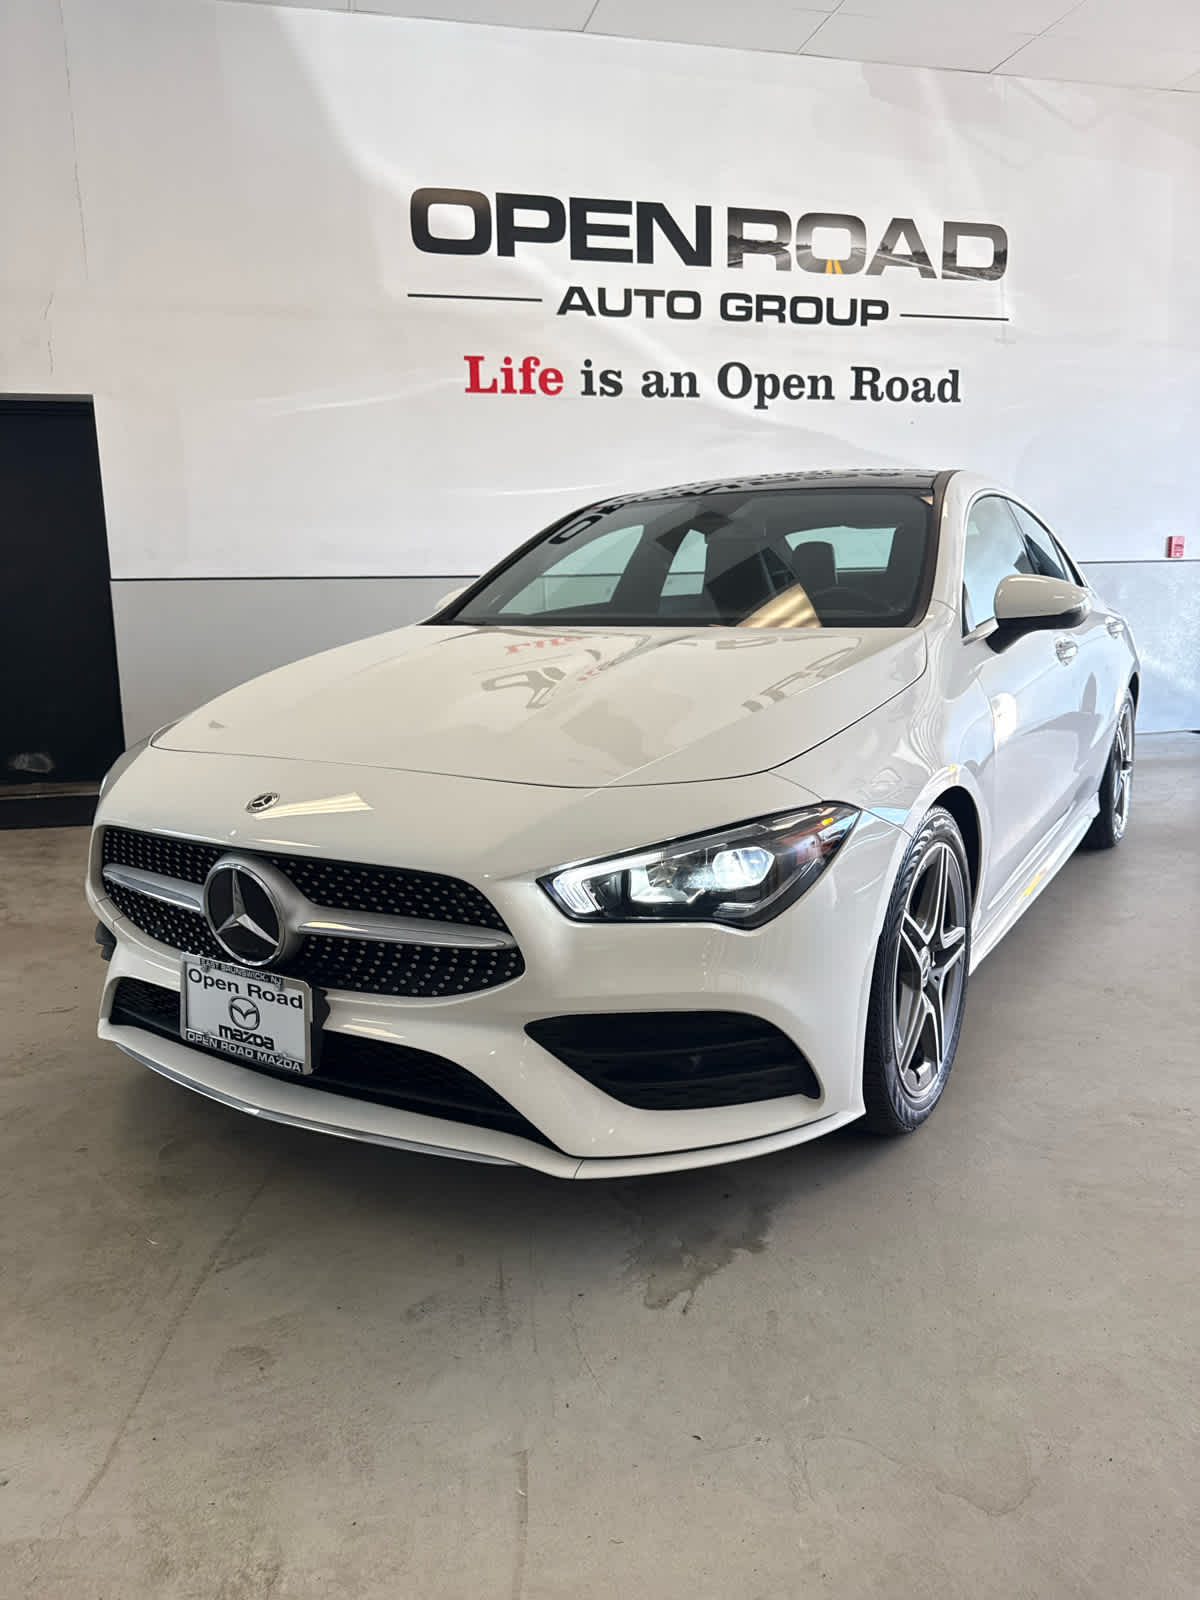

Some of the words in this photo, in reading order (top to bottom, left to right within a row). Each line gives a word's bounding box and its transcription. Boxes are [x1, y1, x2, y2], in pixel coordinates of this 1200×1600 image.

[410, 187, 712, 268] OPEN
[727, 206, 1008, 281] ROAD
[556, 286, 702, 320] AUTO
[719, 292, 889, 327] GROUP
[463, 355, 564, 396] Life
[580, 359, 623, 398] is
[641, 370, 701, 399] an
[717, 361, 836, 410] Open
[849, 366, 961, 403] Road
[188, 968, 239, 994] Open
[247, 983, 303, 1009] Road
[187, 1032, 218, 1049] OPEN
[221, 1042, 254, 1059] ROAD
[257, 1052, 302, 1072] MAZDA
